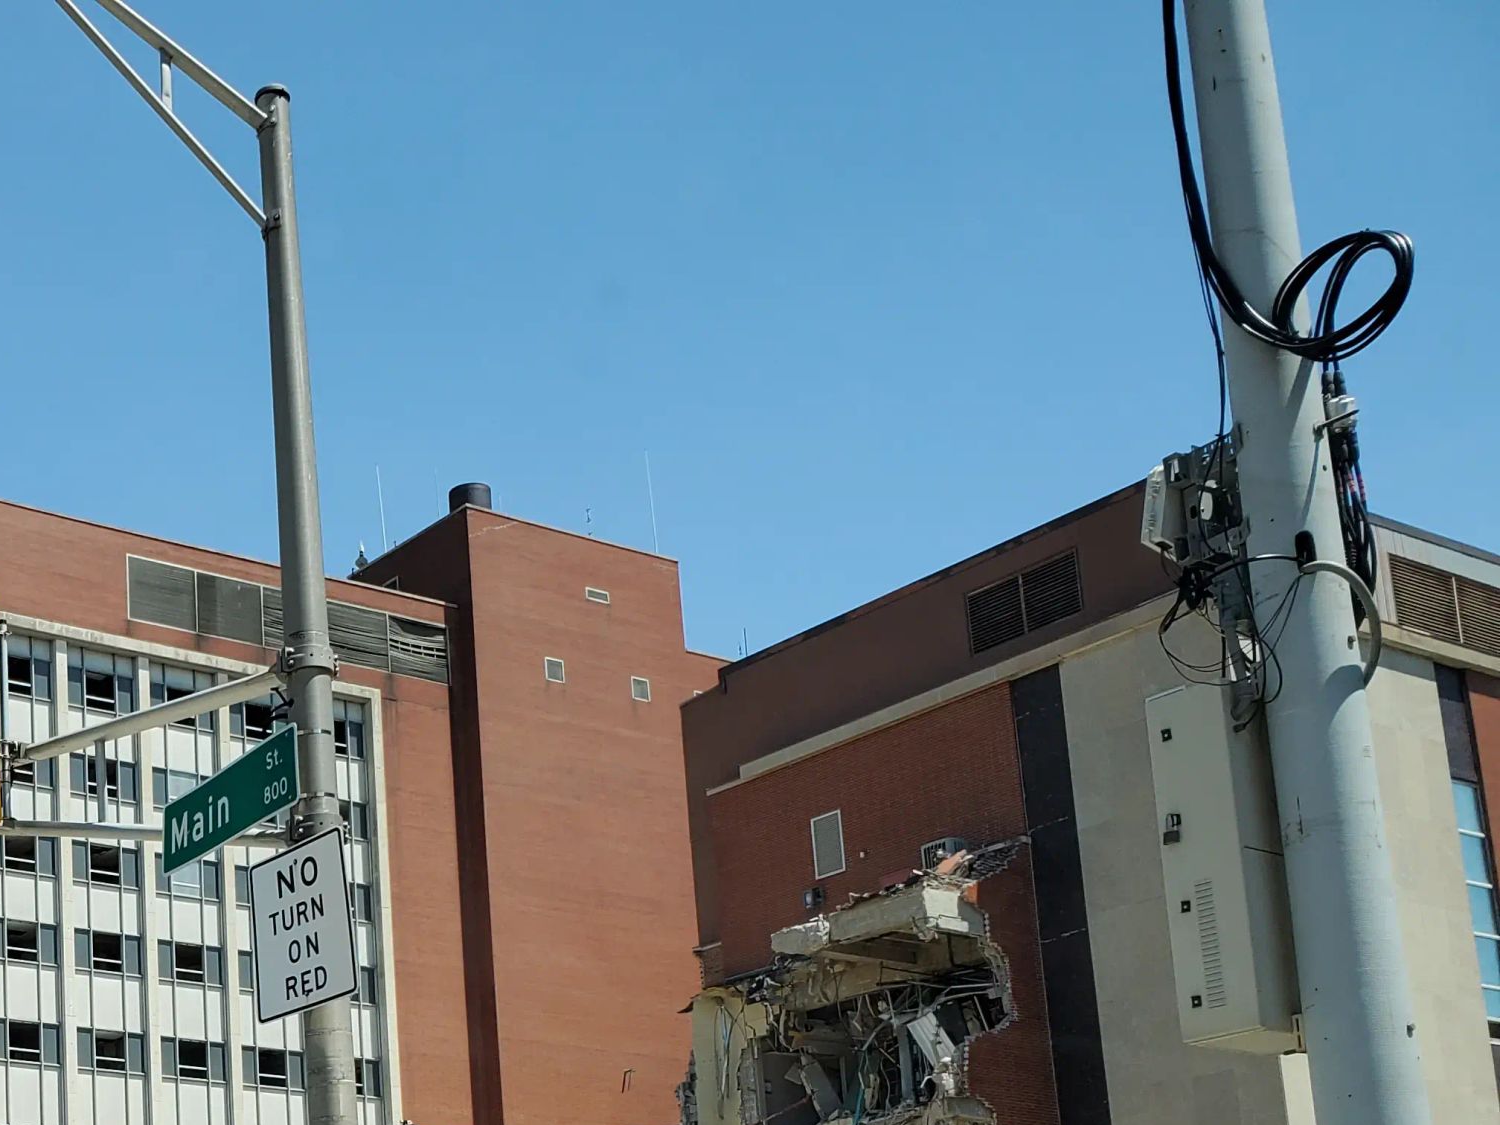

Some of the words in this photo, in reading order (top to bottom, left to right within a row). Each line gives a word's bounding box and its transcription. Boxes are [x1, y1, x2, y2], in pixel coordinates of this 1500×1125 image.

[265, 748, 283, 770] St.
[263, 776, 288, 804] 800
[171, 795, 230, 854] Main
[276, 856, 318, 899] NO
[268, 893, 325, 936] TURN
[288, 931, 320, 964] ON
[285, 965, 328, 1001] RED
